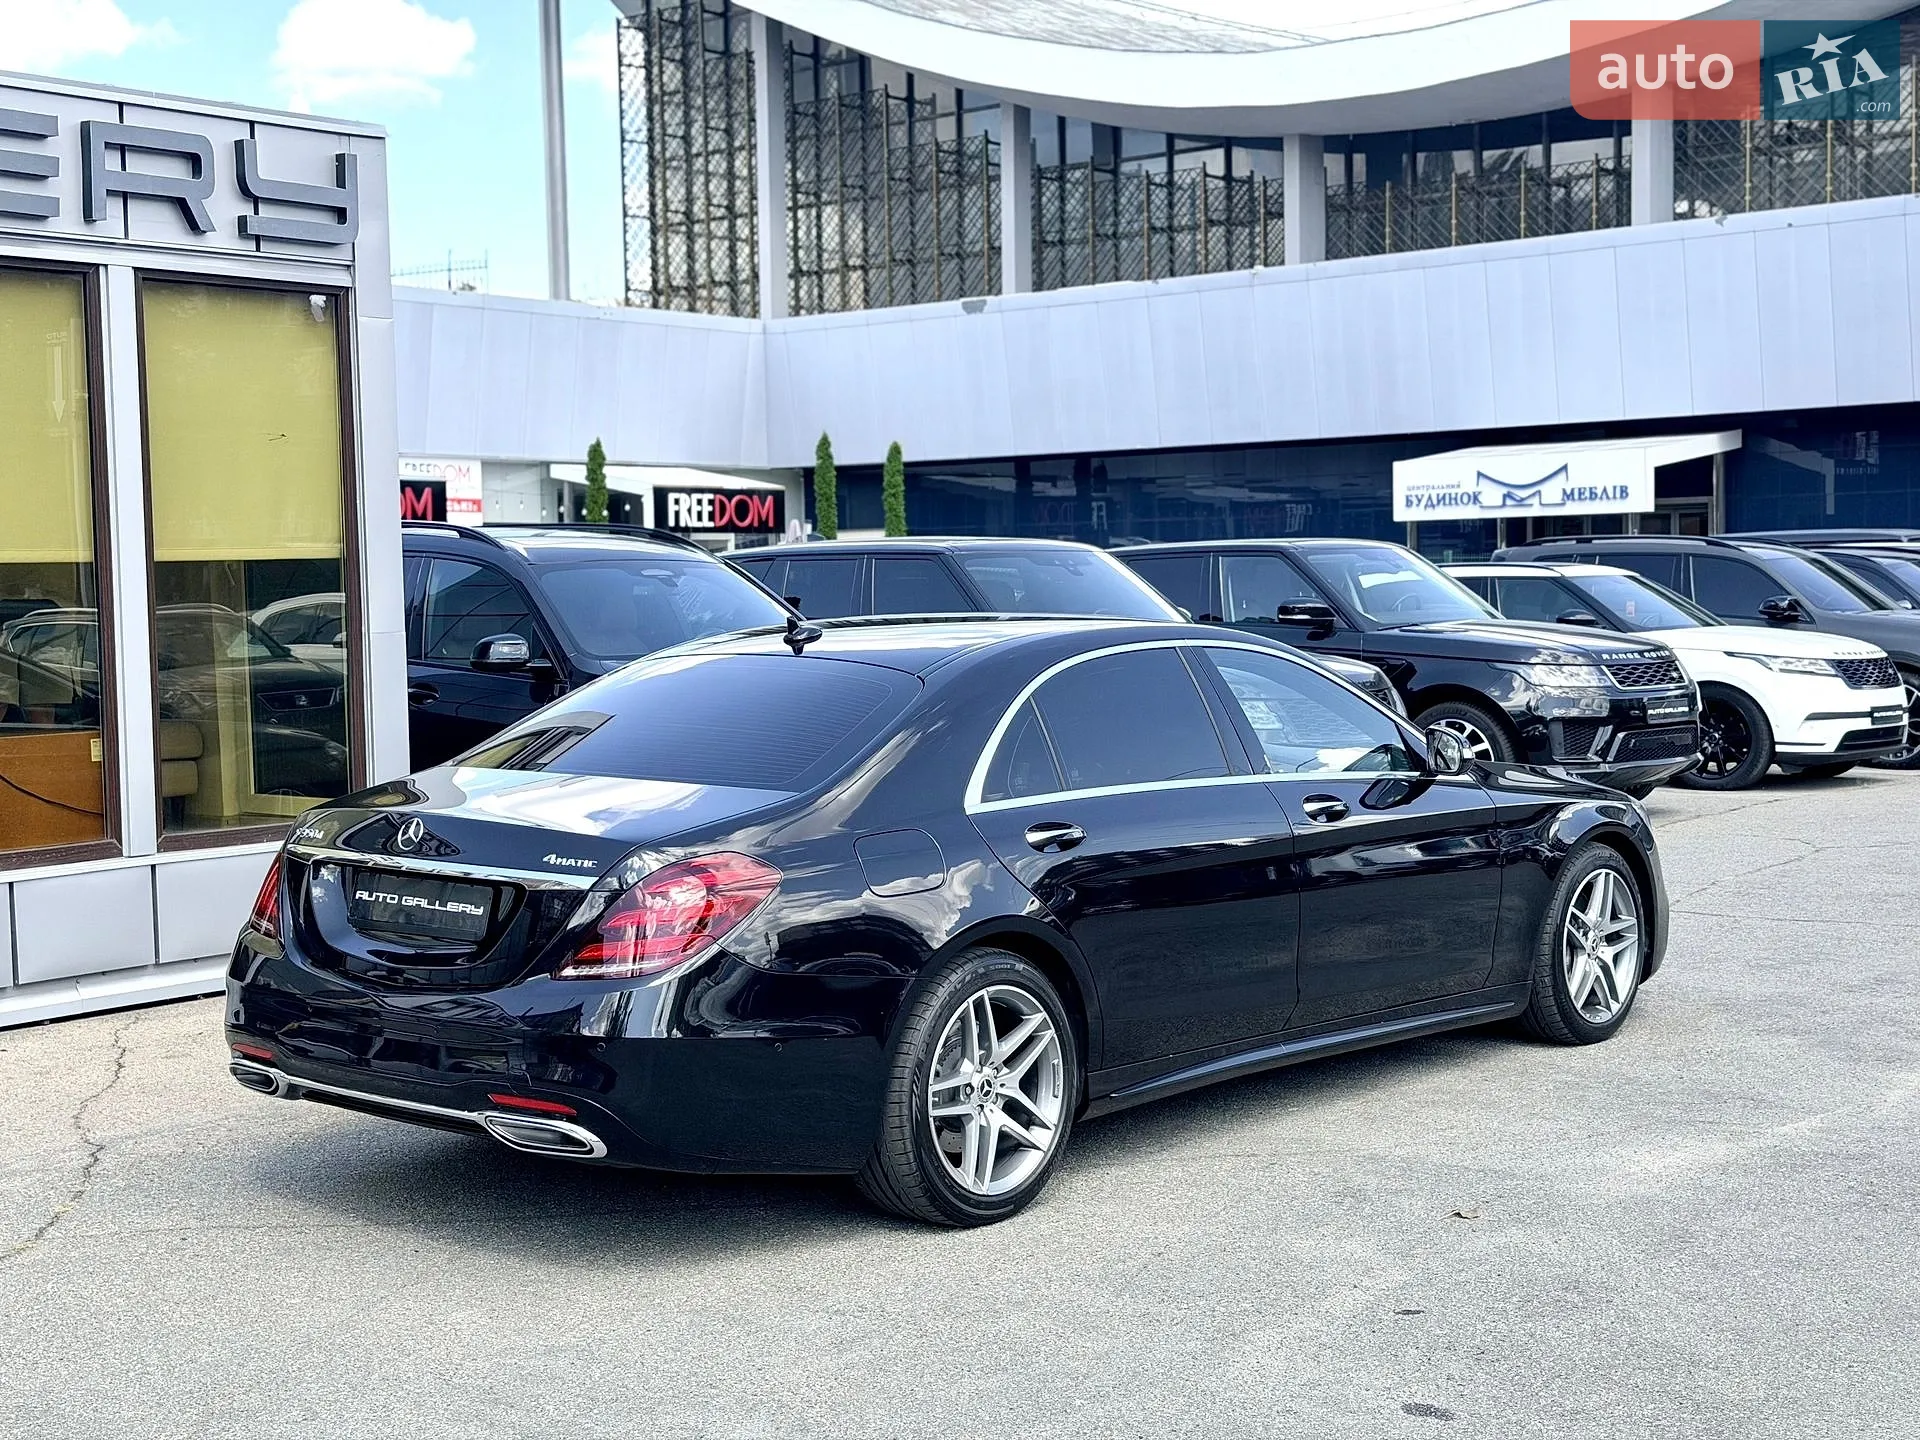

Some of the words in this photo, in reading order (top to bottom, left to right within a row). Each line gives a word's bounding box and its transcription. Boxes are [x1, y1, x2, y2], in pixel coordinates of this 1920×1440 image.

[667, 492, 775, 528] FREEDOM
[1404, 491, 1483, 511] БУДИНОК
[1561, 485, 1630, 502] МЕБЛІВ
[1601, 652, 1641, 660] RANGE
[542, 853, 598, 868] 4MATIC
[355, 890, 399, 904] AUTO
[401, 896, 484, 915] GALLERY
